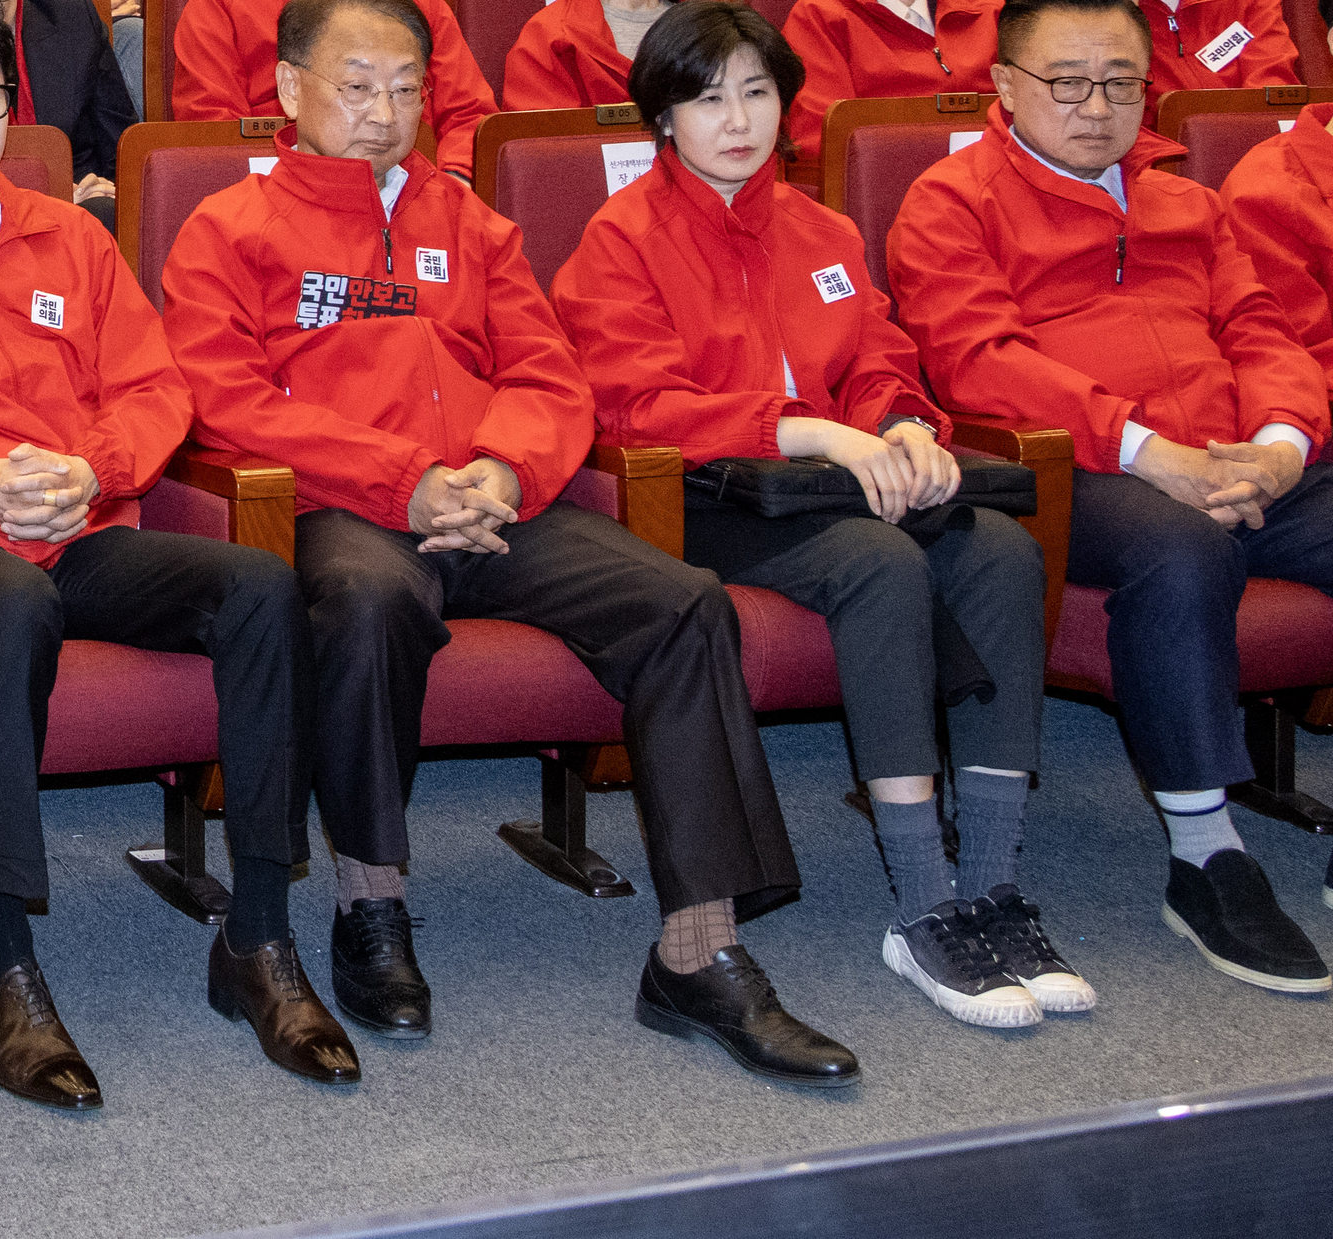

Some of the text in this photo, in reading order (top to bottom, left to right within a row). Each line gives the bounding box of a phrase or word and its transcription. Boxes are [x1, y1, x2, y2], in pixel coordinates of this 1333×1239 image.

[1207, 31, 1245, 63] 국민의힘
[253, 121, 276, 130] B 06
[424, 255, 441, 265] 국민
[424, 263, 442, 277] 의힘
[821, 271, 841, 285] 국민
[826, 281, 847, 295] 의힘
[39, 295, 57, 310] 국민
[38, 305, 56, 321] 의힘
